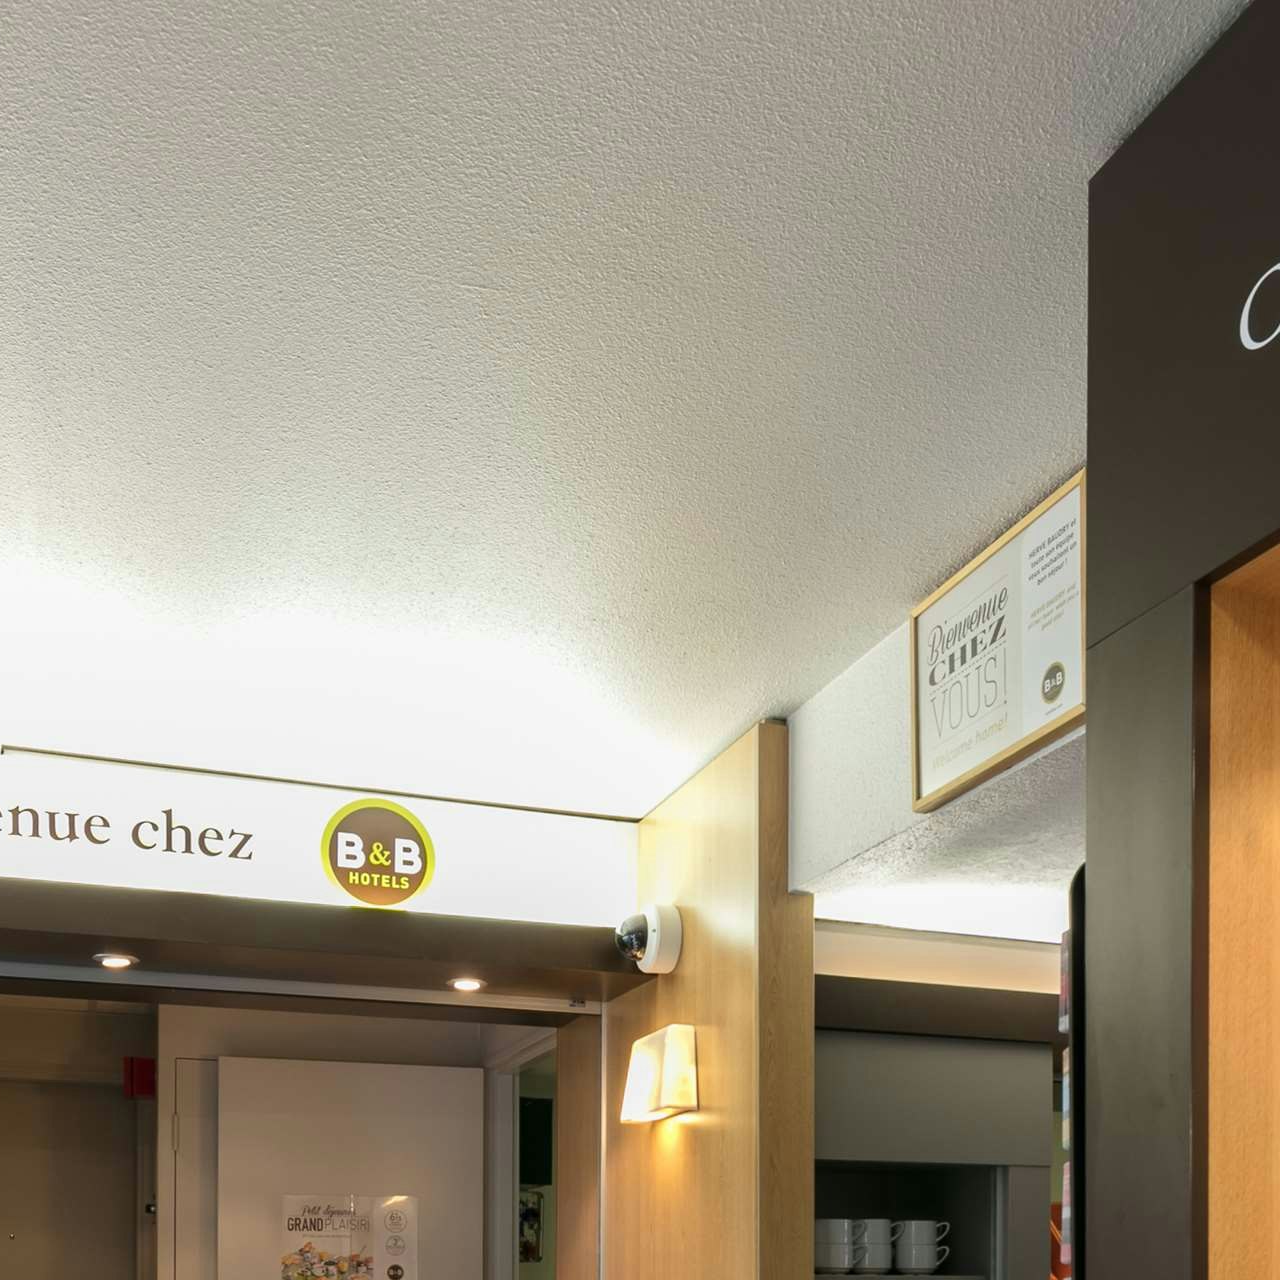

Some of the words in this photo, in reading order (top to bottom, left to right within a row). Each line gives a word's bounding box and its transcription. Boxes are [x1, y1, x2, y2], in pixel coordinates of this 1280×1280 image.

[928, 587, 1008, 666] Bienvenue
[929, 615, 1007, 686] CHEZ
[131, 809, 254, 860] chez
[337, 832, 422, 875] B&B
[349, 872, 410, 888] HOTELS
[287, 1217, 323, 1231] GRAND
